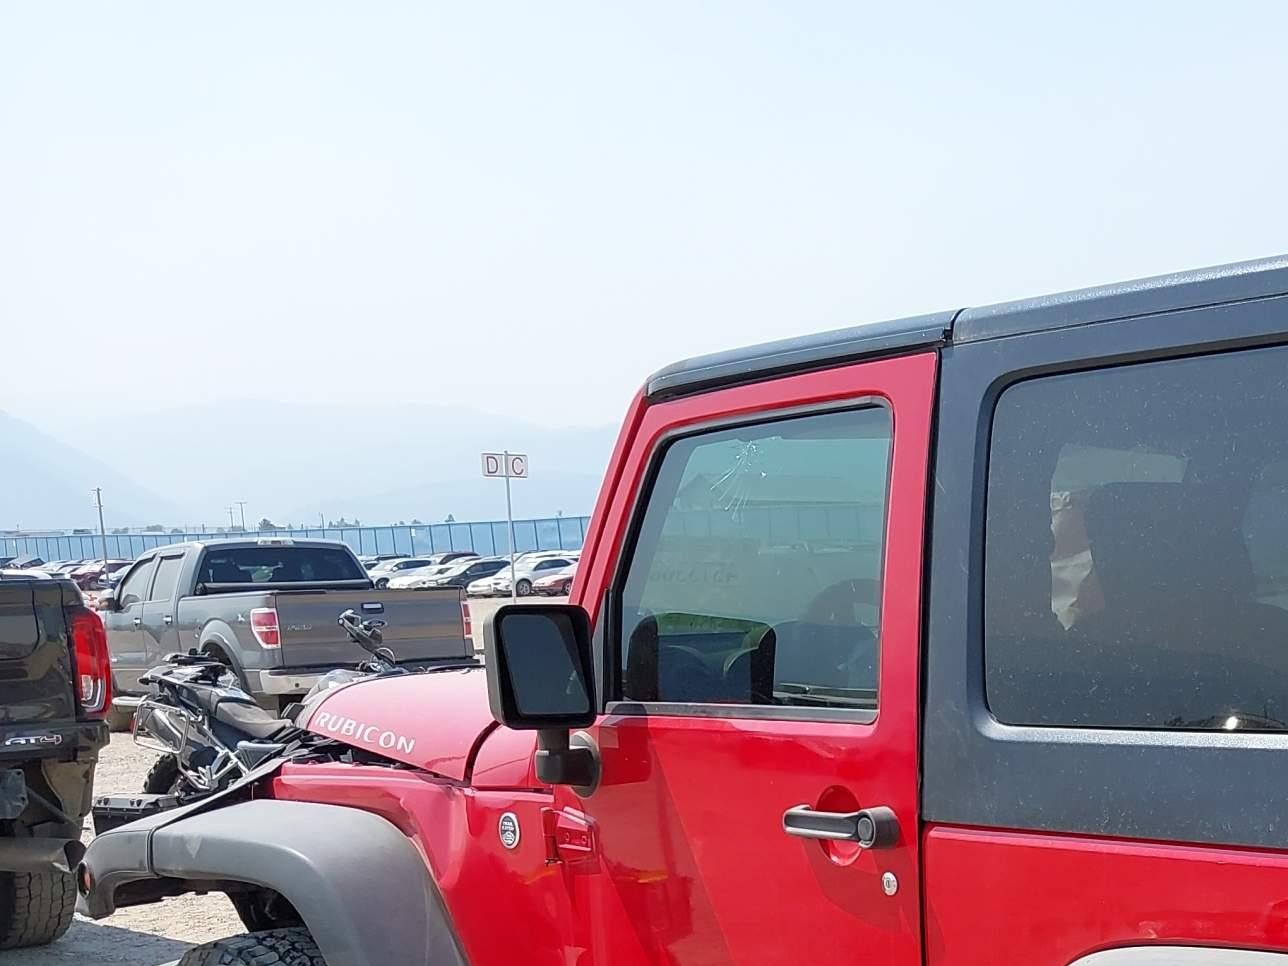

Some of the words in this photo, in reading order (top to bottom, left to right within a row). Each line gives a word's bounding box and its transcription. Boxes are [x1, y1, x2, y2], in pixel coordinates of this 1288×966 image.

[487, 456, 498, 474] D
[512, 457, 524, 475] C
[5, 735, 62, 745] AT4
[315, 712, 415, 754] RUBICON
